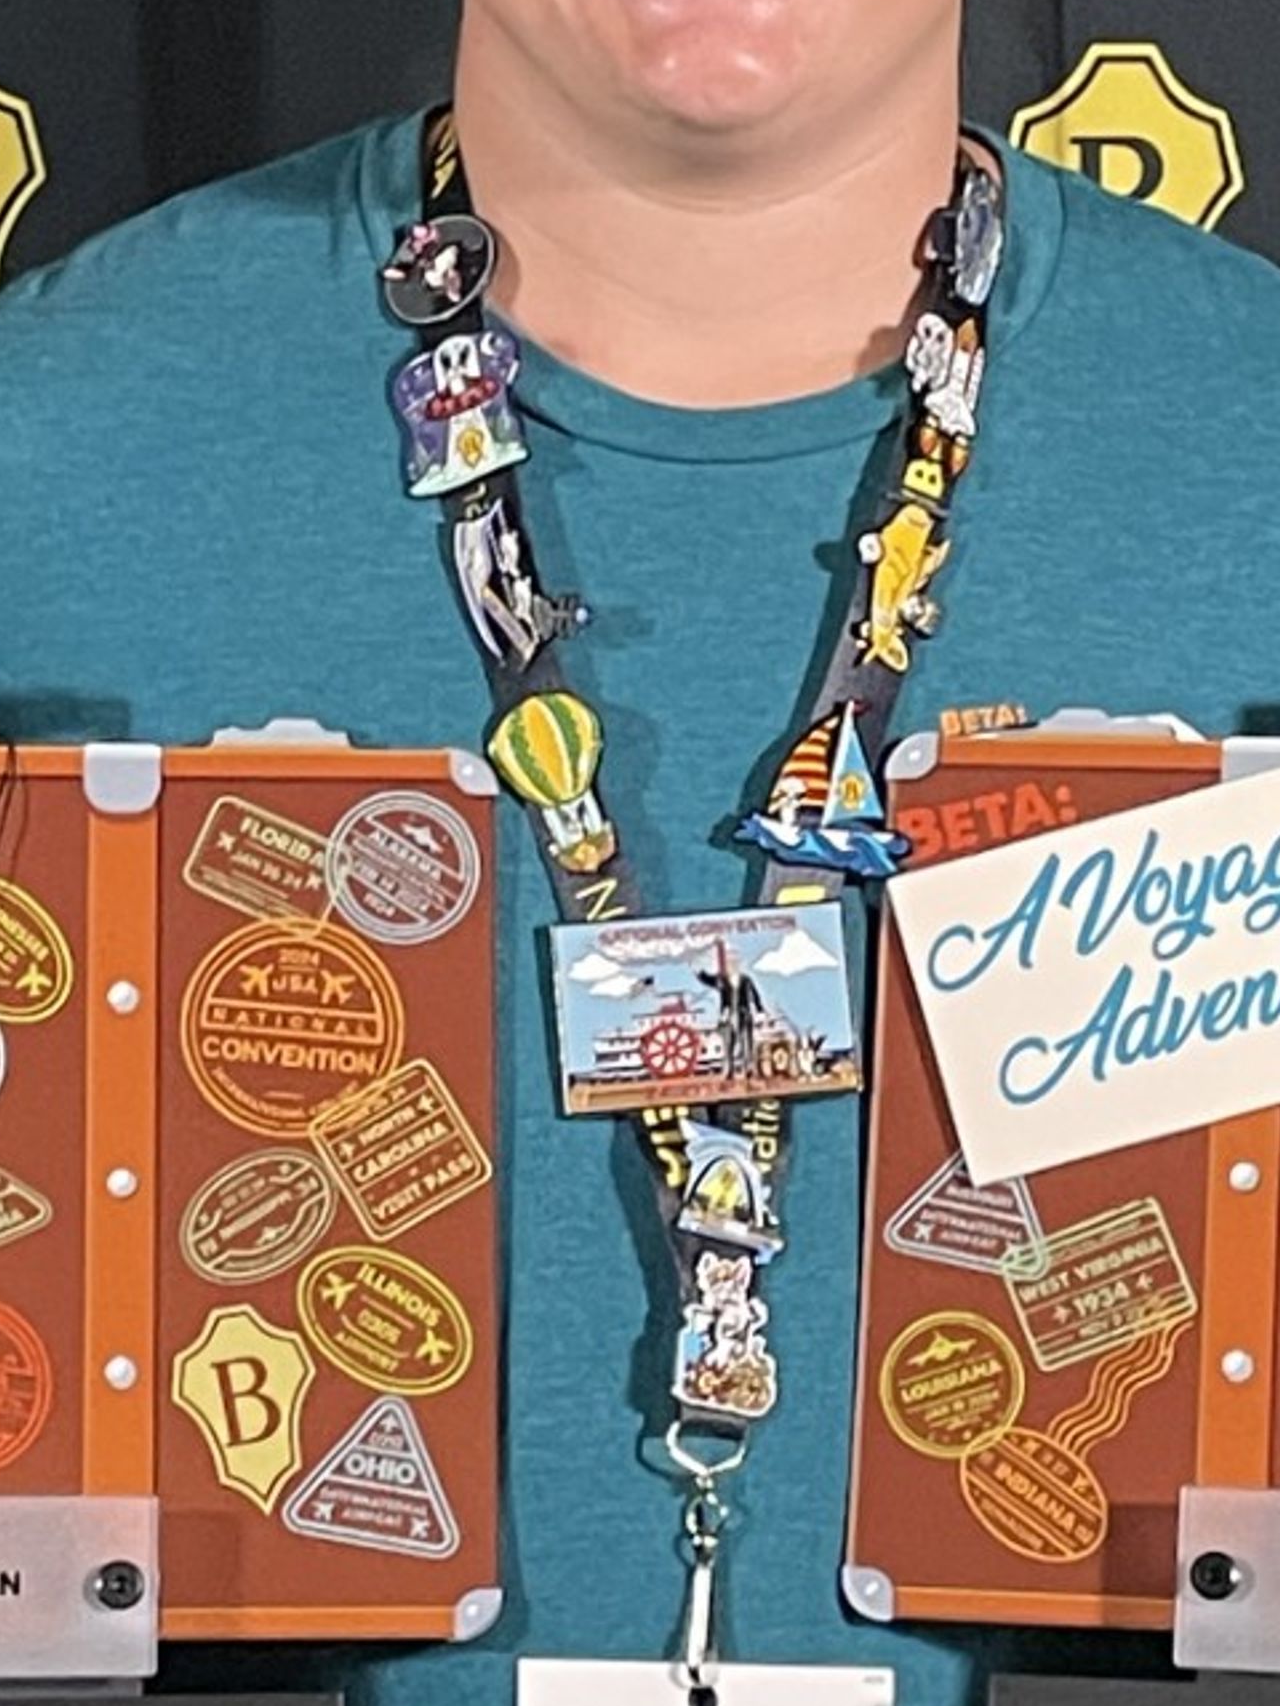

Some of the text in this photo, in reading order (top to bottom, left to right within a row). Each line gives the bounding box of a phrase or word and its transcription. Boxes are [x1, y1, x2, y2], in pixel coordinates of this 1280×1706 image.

[239, 816, 330, 869] FLORIDA
[896, 781, 1077, 860] BETA:
[927, 852, 1061, 992] A
[211, 1006, 370, 1039] NATIONAL
[201, 1035, 378, 1076] CONVENTION
[351, 1121, 449, 1184] CAROLINA
[357, 1105, 417, 1144] NORTH
[421, 1151, 474, 1192] PASS
[356, 1262, 443, 1328] ILLINOIS
[1018, 1270, 1069, 1304] WEST
[1072, 1236, 1165, 1281] VIRGINIA
[209, 1354, 281, 1450] B
[899, 1358, 1003, 1405] LOUISIANA
[343, 1451, 418, 1485] OHIO
[993, 1462, 1077, 1531] INDIANA
